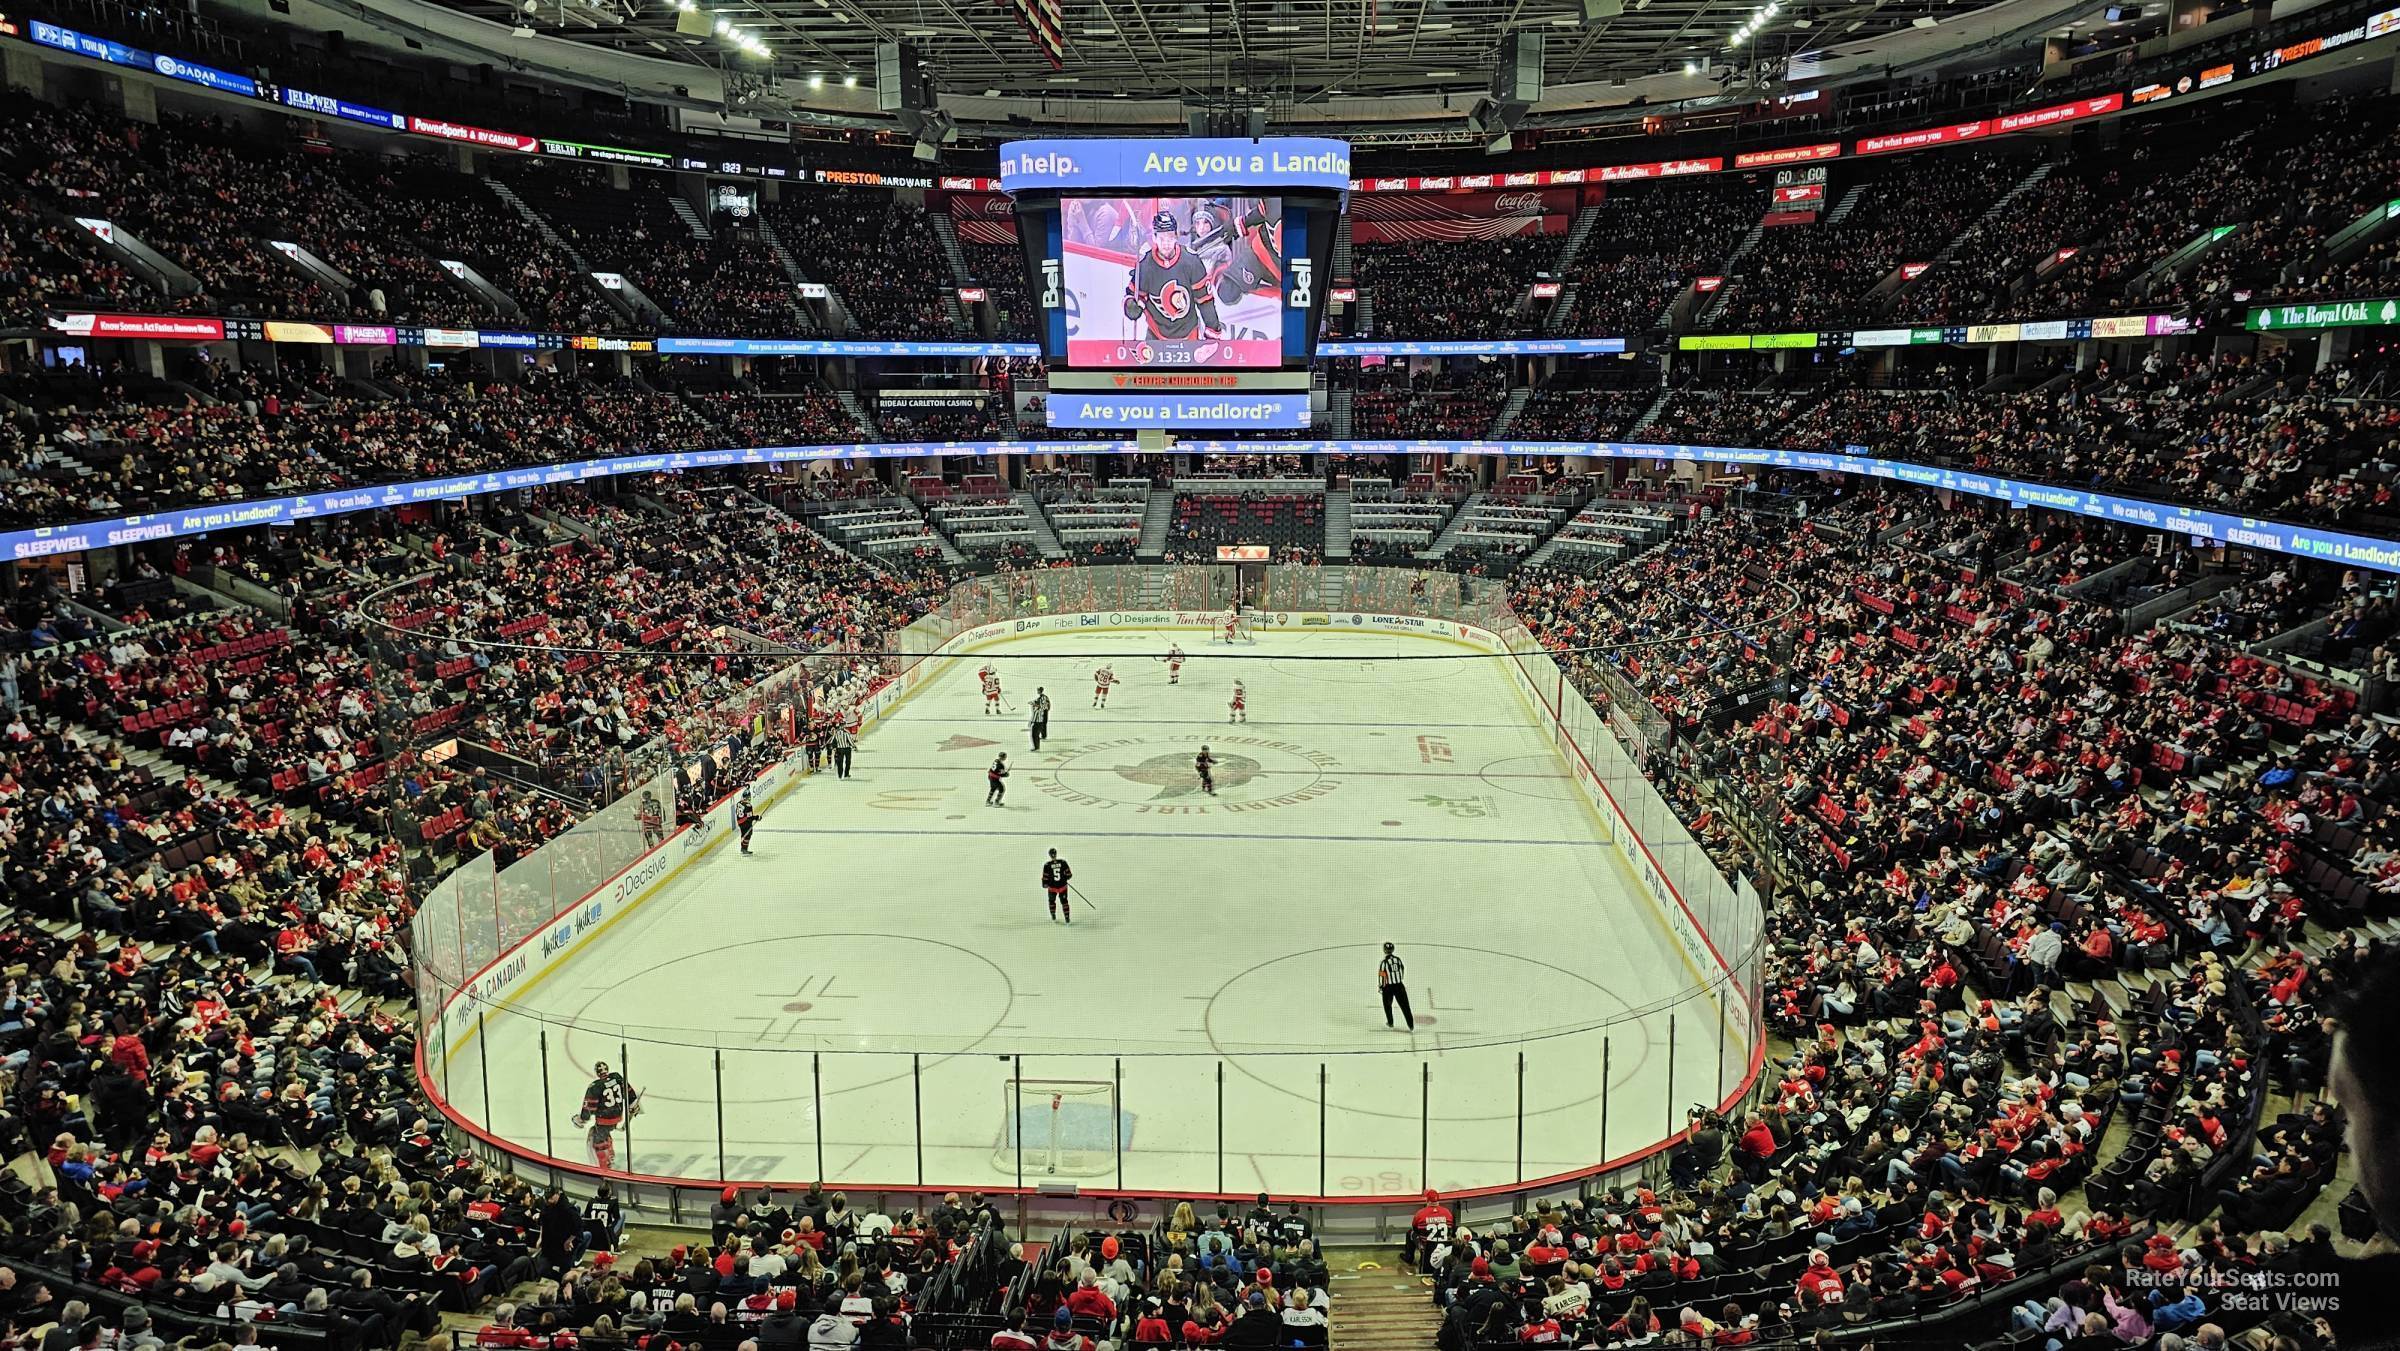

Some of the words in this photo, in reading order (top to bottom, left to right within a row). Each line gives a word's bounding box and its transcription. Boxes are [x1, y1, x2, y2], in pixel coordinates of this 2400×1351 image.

[2281, 37, 2323, 62] PRESTON
[2322, 26, 2366, 50] HARDWARE
[177, 65, 216, 83] GADAR
[2001, 118, 2017, 129] Find
[2018, 115, 2036, 125] what
[2036, 111, 2060, 121] moves
[2060, 108, 2075, 119] you
[415, 118, 468, 138] PowerSports
[479, 132, 488, 141] RV
[489, 134, 519, 146] CANADA
[1867, 139, 1883, 151] Find
[1884, 137, 1902, 147] what
[1903, 134, 1926, 144] moves
[1927, 131, 1942, 142] you
[1021, 152, 1081, 177] help.
[1144, 152, 1188, 173] Are
[1197, 155, 1241, 177] you
[1250, 156, 1264, 172] a
[1738, 154, 1754, 165] Find
[1755, 152, 1773, 162] what
[1773, 151, 1796, 160] moves
[1797, 150, 1811, 159] you
[1617, 166, 1649, 179] Hortons
[1661, 163, 1676, 176] Tim
[1677, 161, 1710, 174] Hortons
[1777, 171, 1792, 184] GO
[1807, 167, 1826, 181] GO!
[827, 171, 880, 185] PRESTON
[880, 177, 932, 188] HARDWARE
[720, 195, 749, 207] SENS
[1495, 192, 1547, 210] Coca-Cola
[1042, 259, 1059, 307] Bell
[1291, 258, 1311, 307] Bell
[2282, 307, 2304, 325] The
[2306, 305, 2340, 327] Royal
[2342, 302, 2369, 322] Oak
[353, 327, 388, 338] MAGENTA
[1975, 326, 1997, 341] MNP
[2093, 320, 2116, 336] RE/MAX
[1117, 345, 1128, 361] 0
[1158, 353, 1191, 364] 13:23
[1223, 345, 1234, 361] 0
[880, 399, 907, 408] RIDEAU
[909, 399, 946, 408] CARLETON
[947, 399, 973, 407] CASINO
[1080, 403, 1114, 419] Are
[1118, 405, 1155, 424] you
[1160, 405, 1171, 419] a
[880, 445, 892, 453] We
[1525, 447, 1538, 455] you
[1622, 447, 1634, 455] We
[1798, 455, 1808, 464] We
[413, 487, 425, 498] Are
[426, 485, 438, 497] you
[1961, 477, 1969, 488] We
[1969, 480, 1978, 490] can
[2019, 487, 2028, 499] Are
[2029, 491, 2039, 504] you
[325, 499, 339, 513] We
[340, 499, 357, 509] can
[2113, 504, 2125, 516] We
[2125, 508, 2140, 518] can
[2140, 507, 2158, 523] help.
[183, 515, 202, 529] Are
[204, 512, 223, 528] you
[2167, 517, 2215, 537] SLEEPWELL
[109, 523, 174, 545] SLEEPWELL
[2227, 528, 2282, 550] SLEEPWELL
[15, 535, 90, 558] SLEEPWELL
[2292, 534, 2310, 550] Are
[2313, 539, 2333, 555] you
[2335, 545, 2342, 556] a
[2244, 551, 2253, 560] 116
[1054, 618, 1073, 629] Fibe
[1081, 614, 1099, 626] Bell
[1124, 613, 1170, 626] Desjardins
[1176, 612, 1193, 625] Tim
[1372, 615, 1395, 624] LONE
[1404, 619, 1424, 628] STAR
[975, 626, 1006, 640] FairSquare
[625, 855, 667, 897] Decisive
[1053, 869, 1061, 882] 5
[1681, 917, 1706, 971] Desjardins
[486, 953, 527, 999] CANADIAN
[602, 1085, 623, 1107] 33
[1426, 1223, 1448, 1242] 23
[1554, 1295, 1582, 1312] KARLSSON
